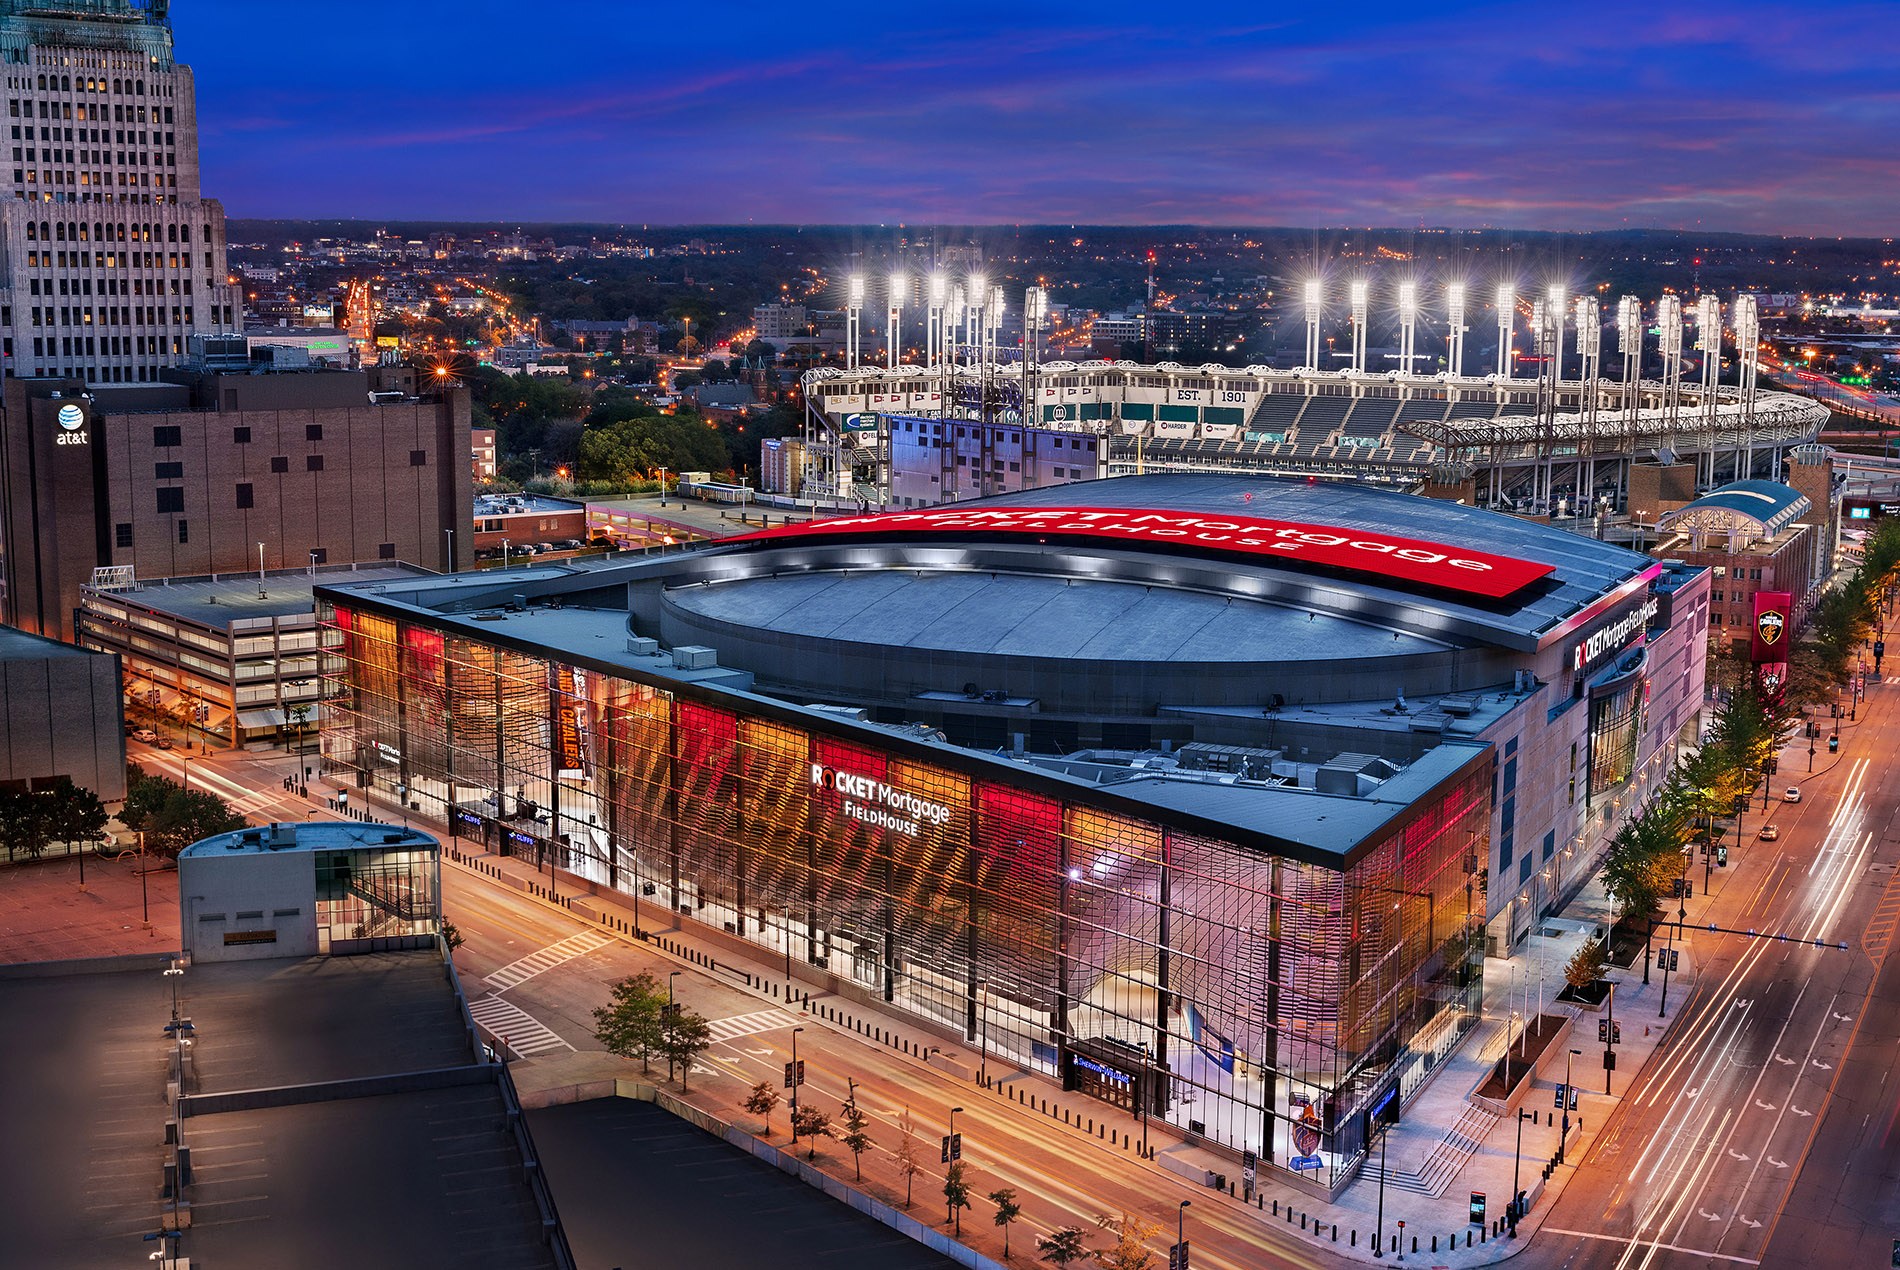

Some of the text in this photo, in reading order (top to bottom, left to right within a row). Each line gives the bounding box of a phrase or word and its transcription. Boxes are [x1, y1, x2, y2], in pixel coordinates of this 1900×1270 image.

[1177, 389, 1247, 403] EST. 1901
[56, 431, 88, 445] at&t
[1121, 514, 1493, 572] Mortgage
[1574, 630, 1604, 671] ROCKET
[1602, 618, 1630, 648] Mortgage
[560, 708, 580, 769] CAVALIERS
[812, 764, 951, 826] ROCKET Mortgage
[464, 814, 481, 826] CLIFFS
[516, 834, 534, 845] CLIFFS
[1078, 1057, 1131, 1084] SHERWIN-WILLIAMS
